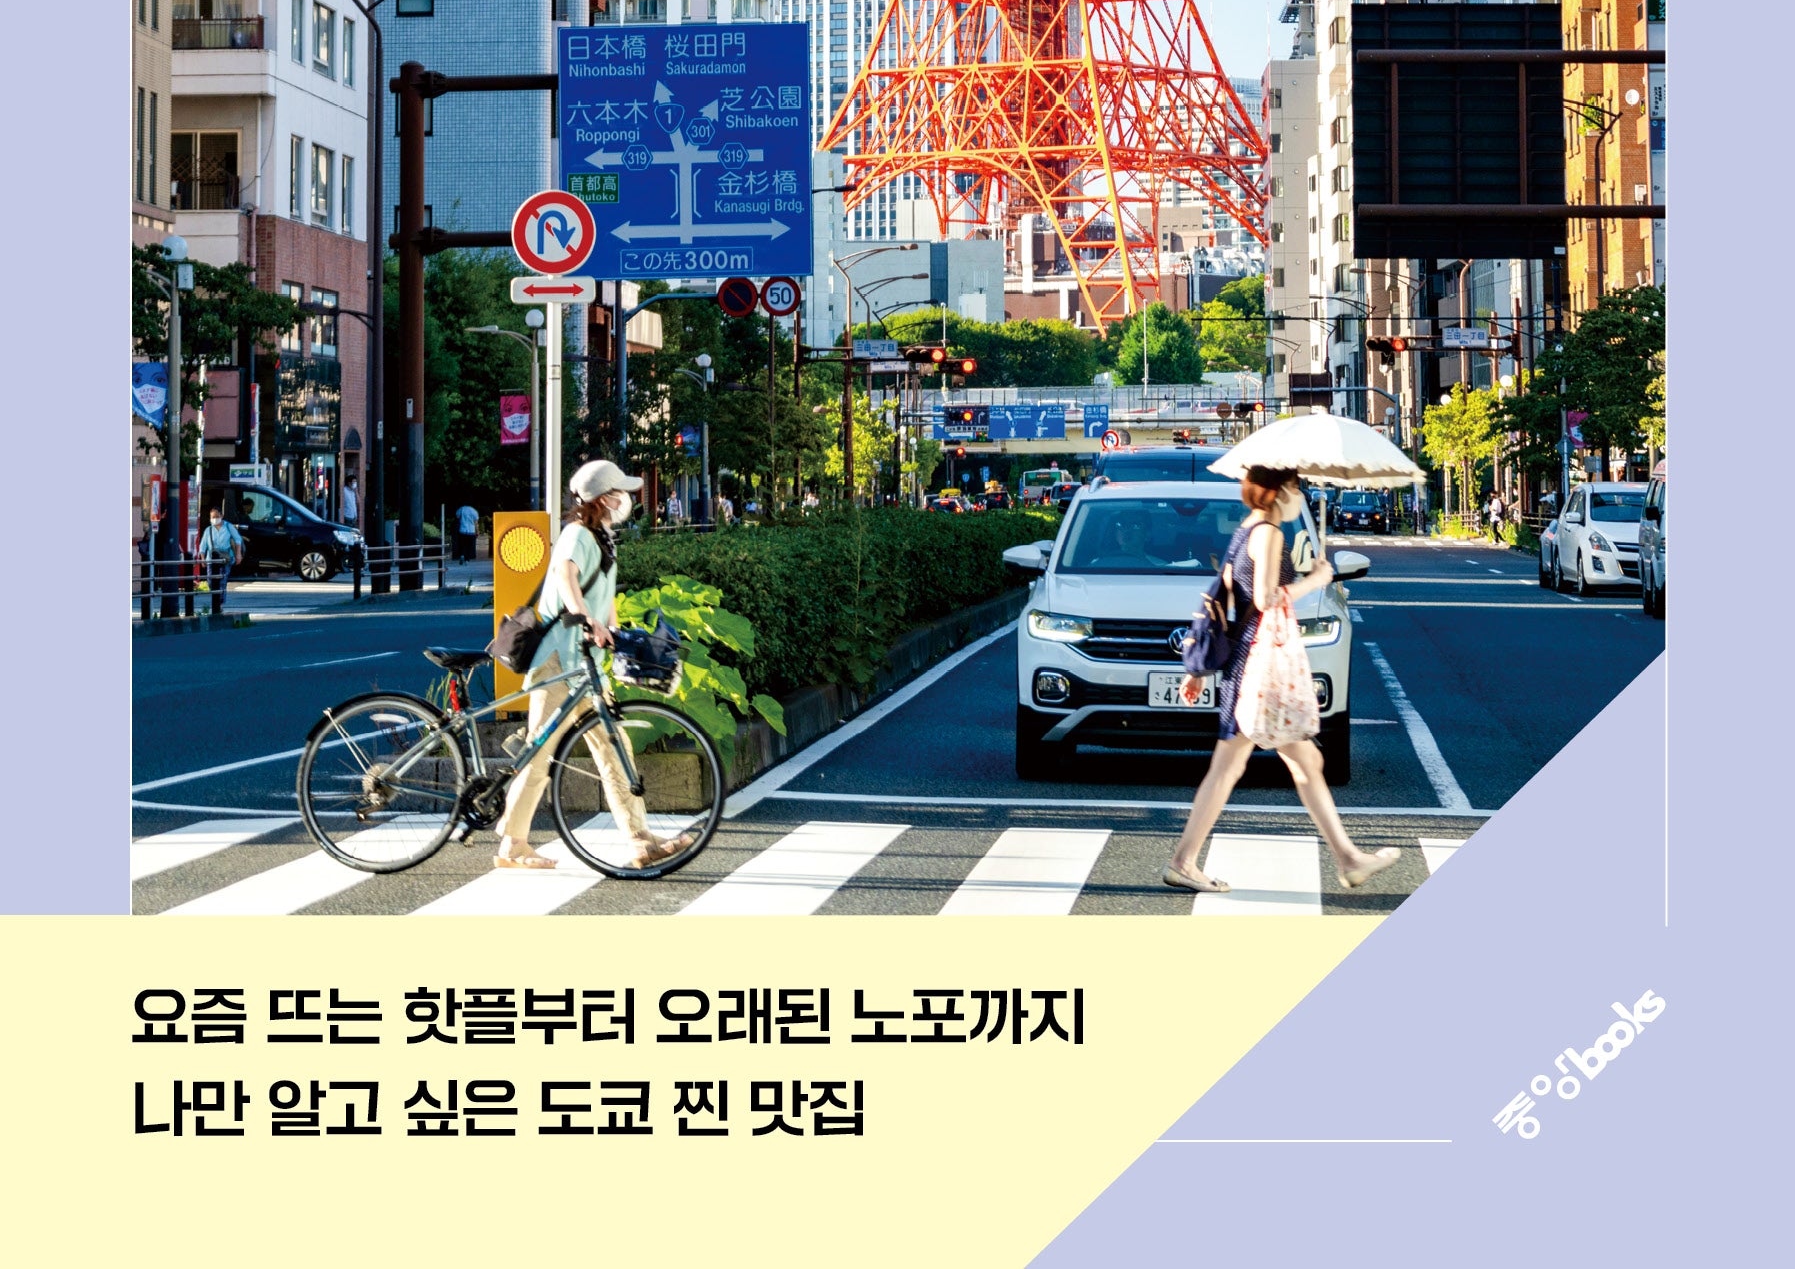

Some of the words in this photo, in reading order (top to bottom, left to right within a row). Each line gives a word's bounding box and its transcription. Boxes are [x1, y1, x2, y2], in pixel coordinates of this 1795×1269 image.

[568, 34, 646, 60] 日本橋
[664, 32, 746, 59] 桜田門
[568, 62, 645, 77] Nihonbashi
[666, 60, 746, 75] Sakuradamon
[720, 86, 802, 112] 芝公園
[566, 99, 648, 126] 六本木
[664, 109, 673, 124] 1
[725, 114, 799, 129] Shibakoen
[576, 127, 640, 145] Roppongi
[691, 125, 710, 138] 301
[627, 152, 648, 166] 319
[723, 149, 744, 163] 319
[570, 175, 617, 191] 首都高
[718, 170, 797, 195] 金杉橋
[714, 199, 770, 214] Kanasugi
[774, 197, 805, 214] Brdg.
[769, 287, 792, 305] 50
